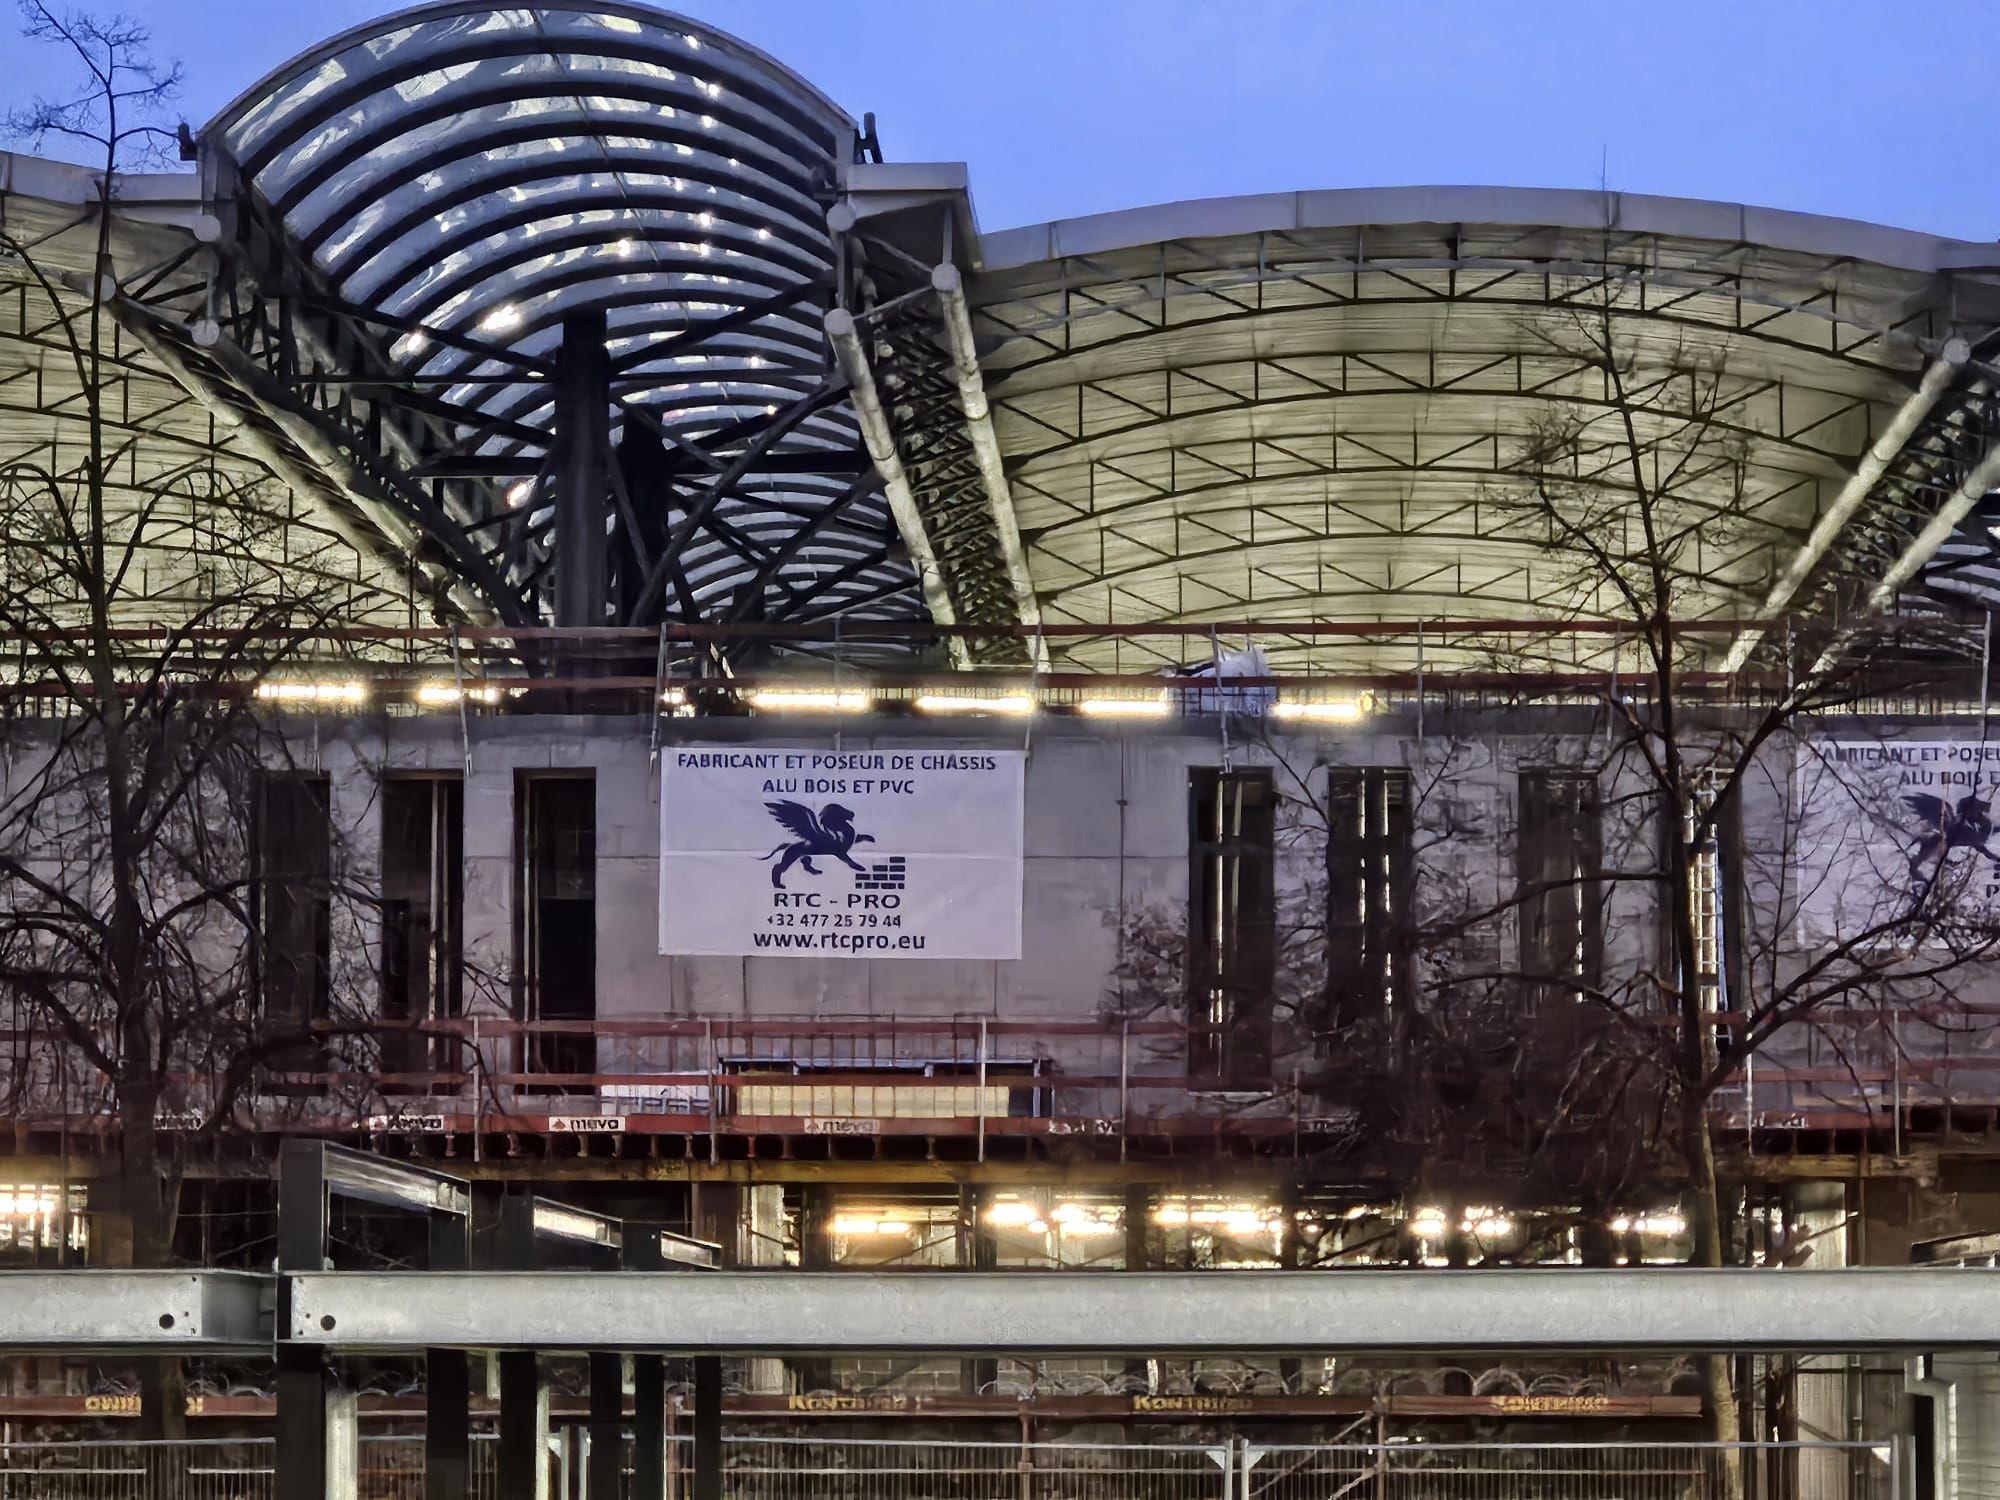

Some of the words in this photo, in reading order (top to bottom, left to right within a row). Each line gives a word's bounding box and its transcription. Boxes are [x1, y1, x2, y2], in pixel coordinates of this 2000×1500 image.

[678, 753, 779, 769] FABRICANT
[786, 755, 805, 769] ET
[812, 755, 884, 770] POSEUR
[891, 755, 914, 770] DE
[762, 778, 797, 793] ALU
[804, 779, 846, 794] BOIS
[853, 780, 875, 794] ET
[880, 780, 915, 794] PVC
[1899, 770, 1933, 786] ALU
[774, 893, 821, 908] RTC
[848, 893, 901, 909] PRO
[767, 914, 794, 927] +32
[800, 914, 829, 927] 477
[858, 914, 878, 928] 79
[882, 914, 901, 928] 44
[753, 932, 926, 954] www.rtcpro.eu
